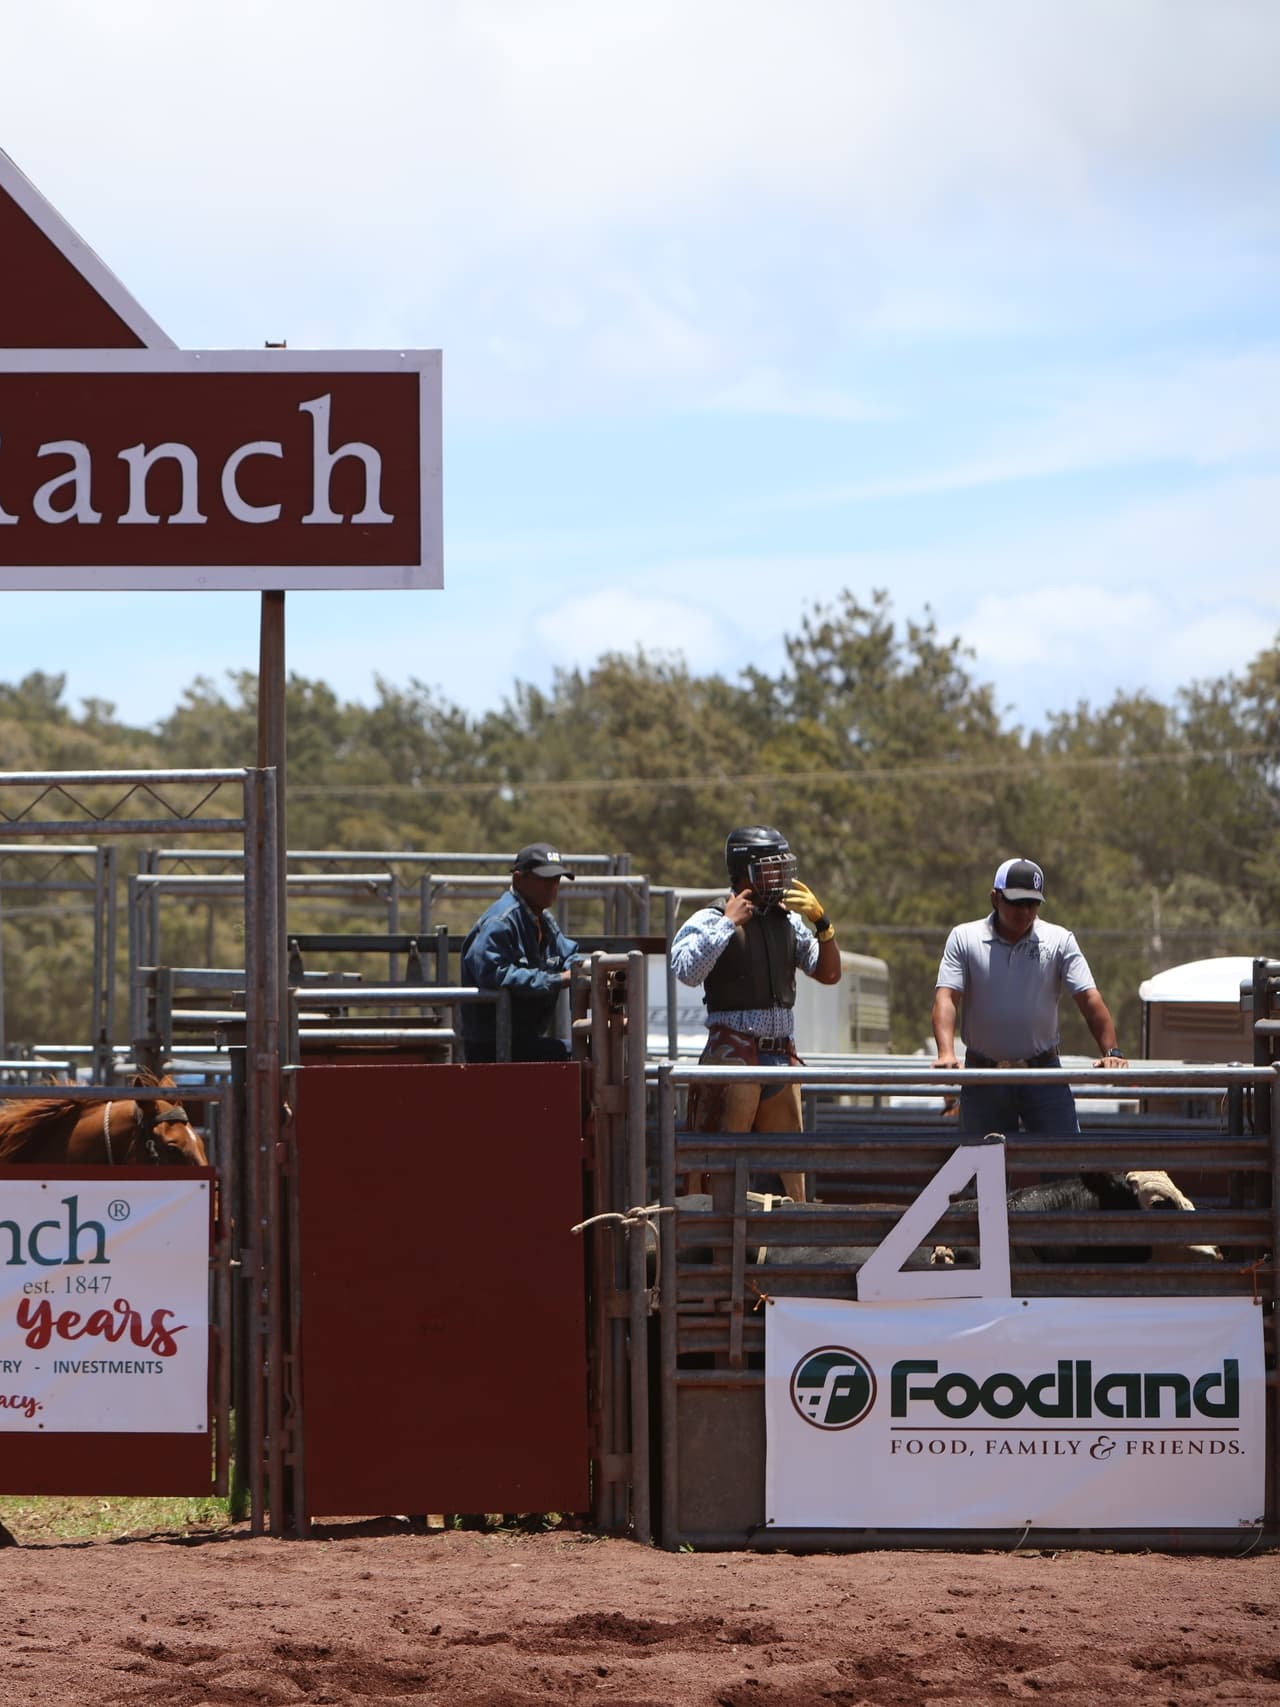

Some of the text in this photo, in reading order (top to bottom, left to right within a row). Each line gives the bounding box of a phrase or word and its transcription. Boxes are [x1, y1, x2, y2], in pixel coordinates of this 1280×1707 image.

[856, 1143, 1012, 1300] 4
[22, 1275, 112, 1295] est. 1847
[16, 1297, 188, 1357] Years
[53, 1360, 164, 1375] INVESTMENTS
[891, 1359, 1239, 1419] Foodland
[891, 1436, 1246, 1461] FOOD, FAMILY & FRIENDS.
